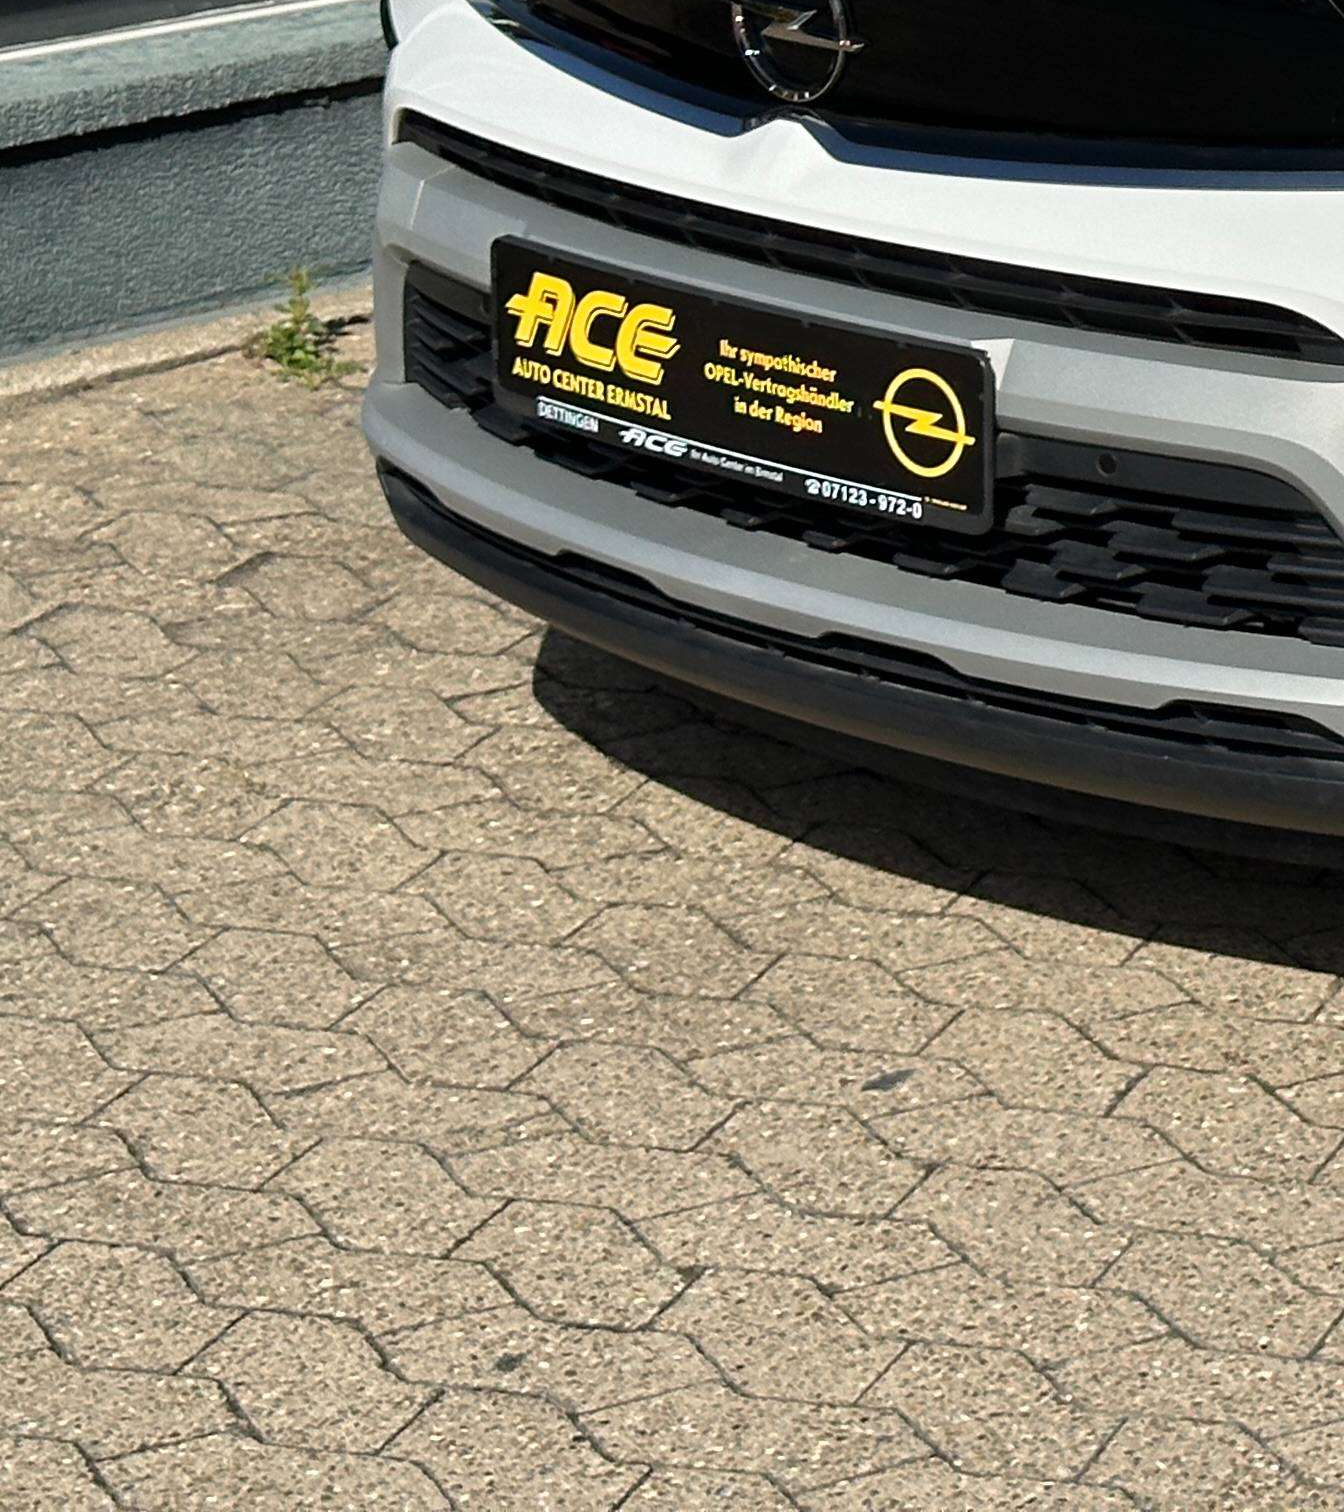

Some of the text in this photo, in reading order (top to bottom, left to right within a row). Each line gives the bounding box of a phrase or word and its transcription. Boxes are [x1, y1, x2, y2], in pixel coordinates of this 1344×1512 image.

[505, 271, 681, 385] ACE
[719, 338, 837, 382] Ihr sympathischer
[512, 356, 672, 420] AUTO CENTER ERMSTAL
[704, 362, 855, 413] OPEL-Vertragshändler
[537, 401, 599, 433] DETTINGEN
[734, 395, 823, 434] in der Region
[618, 426, 689, 458] ACE
